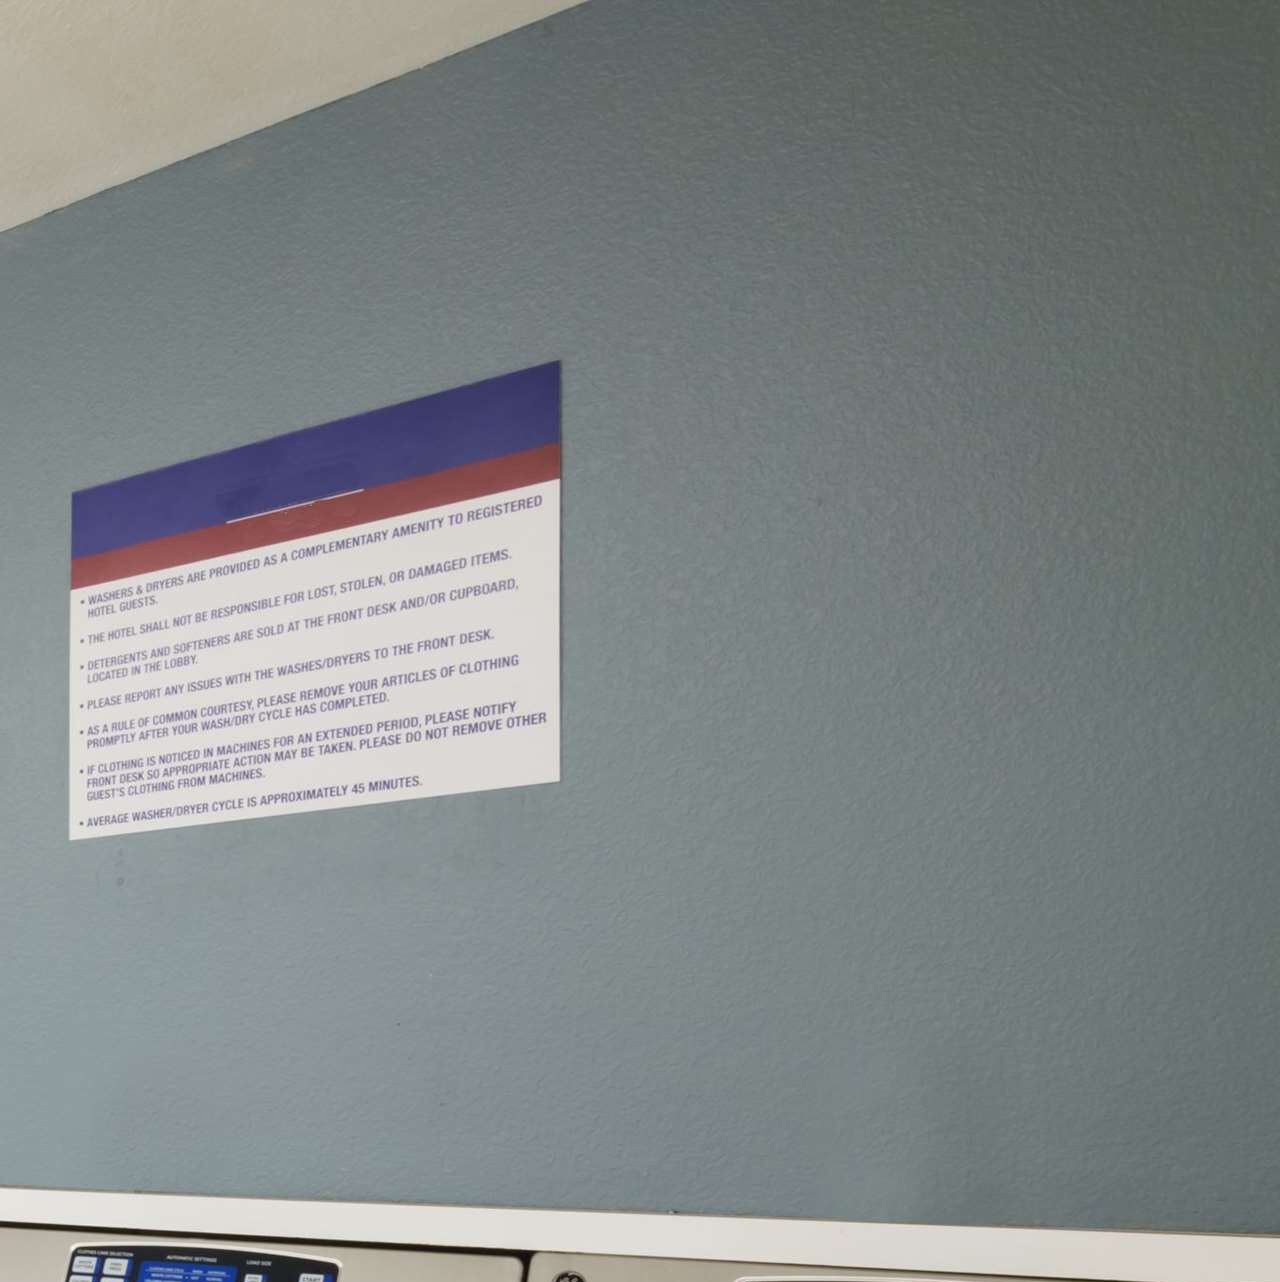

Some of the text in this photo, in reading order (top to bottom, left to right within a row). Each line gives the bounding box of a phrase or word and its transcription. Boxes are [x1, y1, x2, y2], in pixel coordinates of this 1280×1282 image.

[87, 494, 543, 606] WASHERS & DRYERS ARE PROVIDED AS A COMPLEMENTARY AMENITY TO REGISTERED
[87, 548, 513, 646] THE HOTEL SHALL NOT BE RESPONSIBLE FOR LOST, STOLEN, OR DAMAGED ITEMS.
[87, 594, 159, 619] HOTEL GUESTS.
[87, 577, 519, 671] DETERGENTS AND SOFTENERS ARE SOLD AT THE FRONT DESK AND/OR CUPBOARD,
[86, 653, 198, 685] LOCATED IN THE LOBBY.
[86, 628, 495, 711] PLEASE REPORT ANY ISSUES WITH THE WASHES/DRYERS TO THE FRONT DESK.
[86, 653, 520, 737] AS A RULE OF COMMON COURTESY, PLEASE REMOVE YOUR ARTICLES OF CLOTHING
[86, 691, 390, 750] PROMPTLY AFTER YOUR WASH/DRY CYCLE HAS COMPLETED.
[86, 700, 517, 777] IF CLOTHING IS NOTICED IN MACHINES FOR AN EXTENDED PERIOD, PLEASE NOTIFY
[86, 711, 548, 789] FRONT DESK SO APPROPRIATE ACTION MAY BE TAKEN. PLEASE DO NOT REMOVE OTHER
[85, 775, 424, 828] AVERAGE WASHER/DRYER CYCLE IS APPROXIMATELY 45 MINUTES.
[86, 767, 266, 802] GUEST'S CLOTHING FROM MACHINES.
